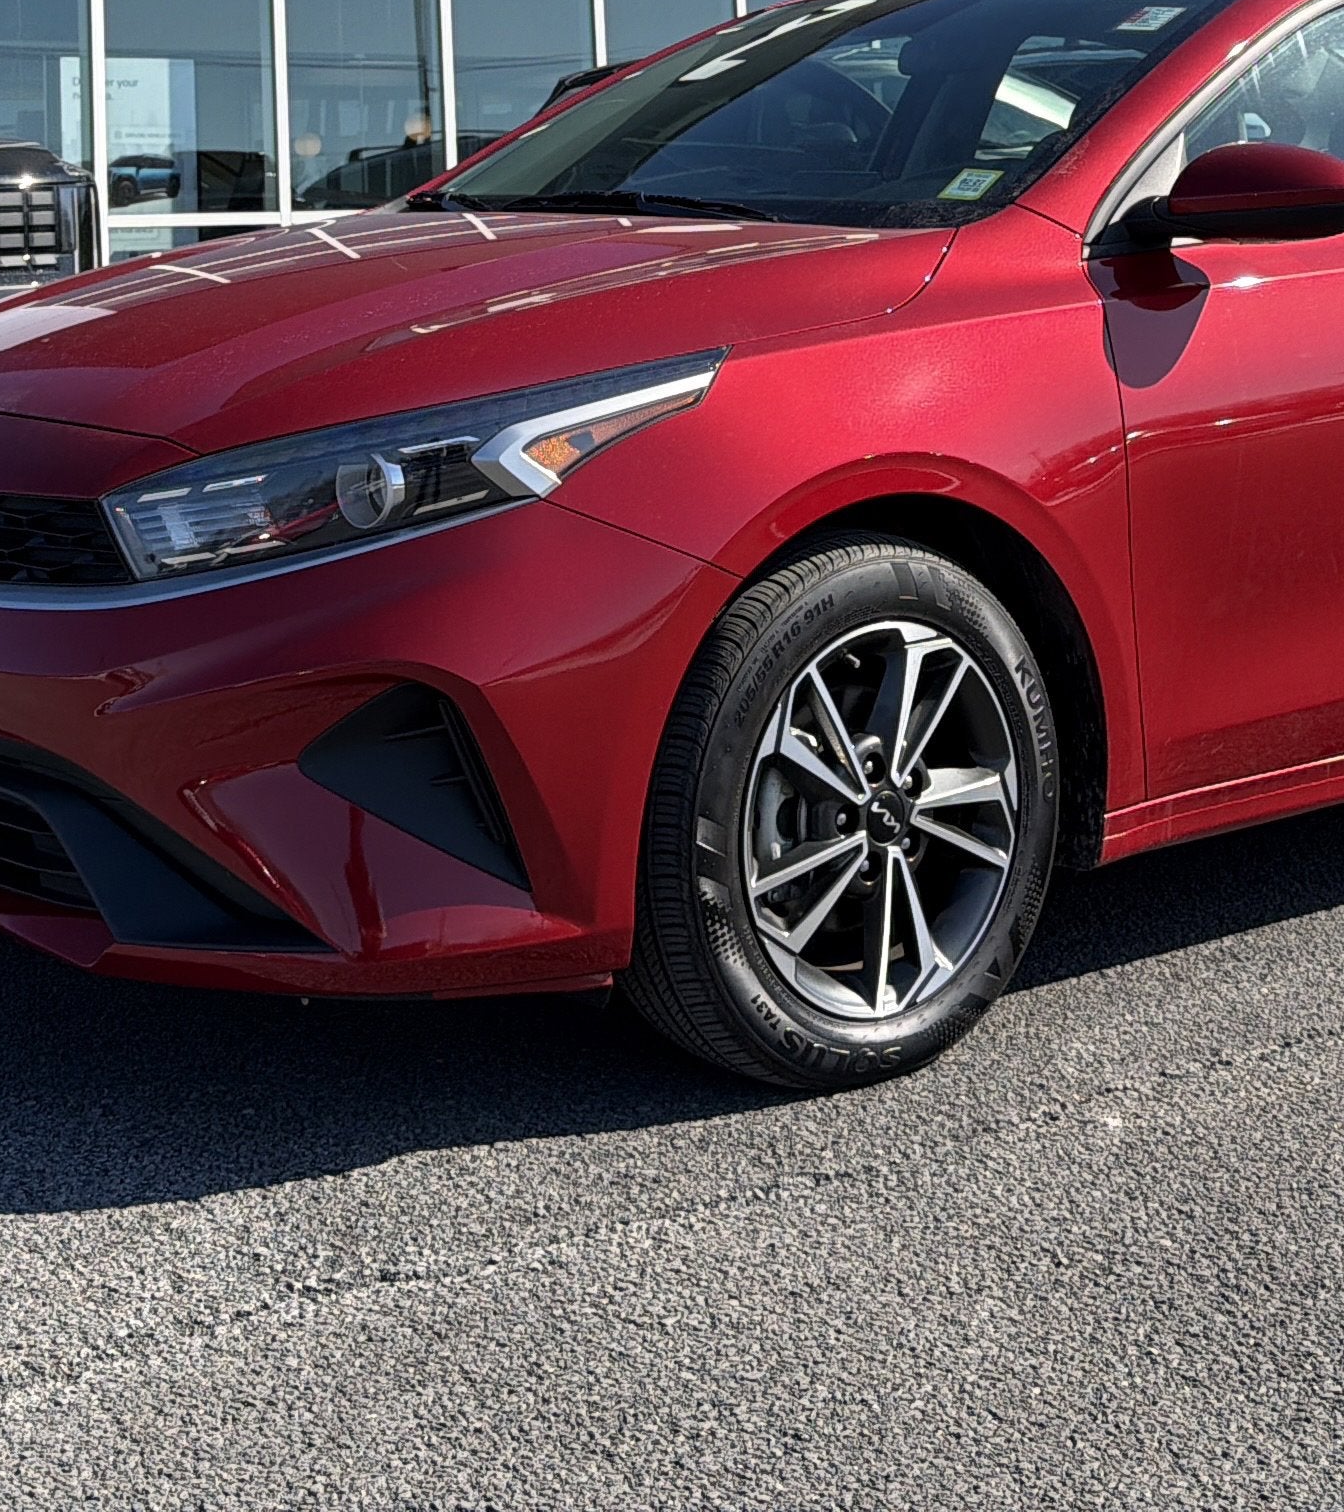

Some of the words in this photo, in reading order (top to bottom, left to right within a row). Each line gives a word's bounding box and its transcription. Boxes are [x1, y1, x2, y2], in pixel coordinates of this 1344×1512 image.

[116, 78, 139, 88] your
[803, 593, 835, 626] 91H
[1014, 654, 1056, 804] KUMHO
[750, 992, 782, 1031] TA31
[779, 1026, 902, 1075] SOLUS
